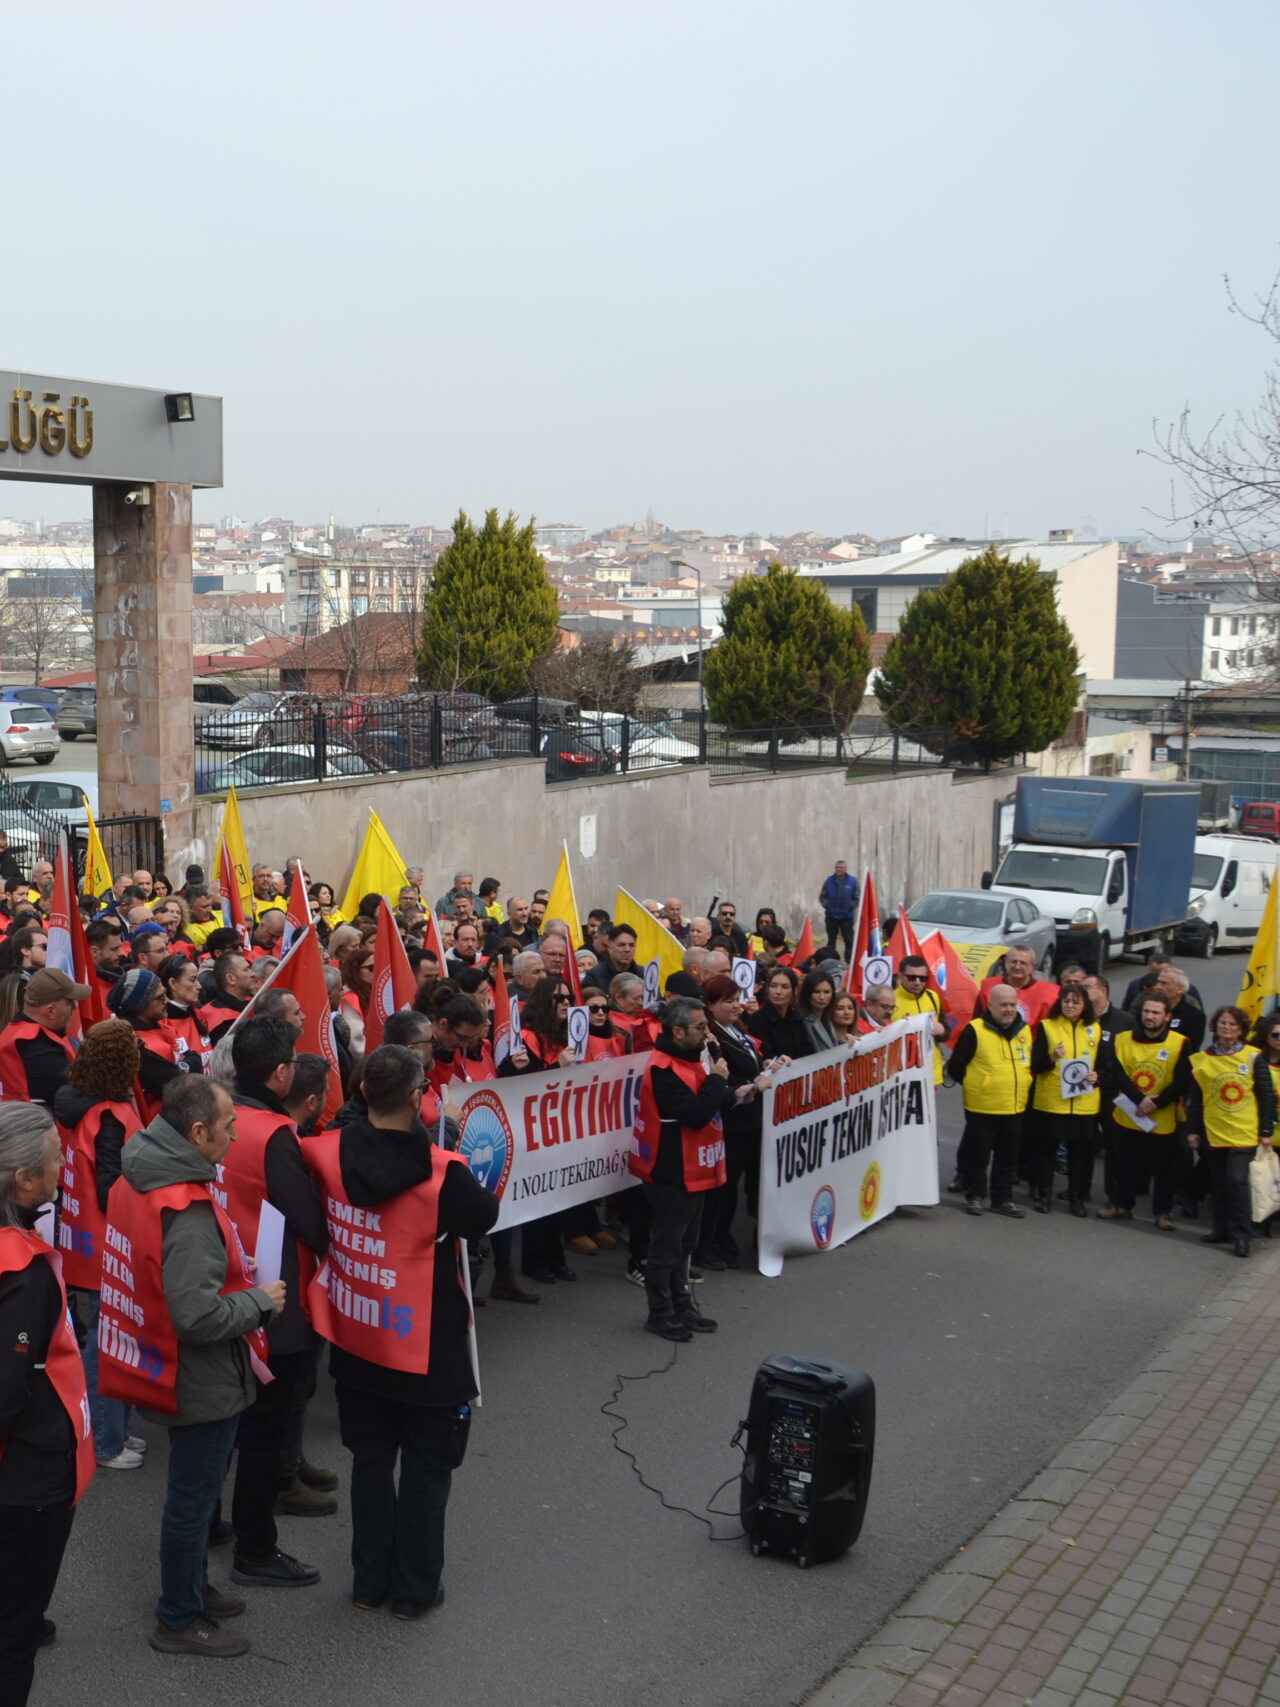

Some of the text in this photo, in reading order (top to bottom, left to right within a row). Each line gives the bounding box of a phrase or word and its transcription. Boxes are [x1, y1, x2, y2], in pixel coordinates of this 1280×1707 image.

[776, 1118, 829, 1189] YUSUF
[831, 1095, 874, 1162] TEKİN
[512, 1181, 518, 1201] 1
[520, 1169, 559, 1199] NOLU
[560, 1149, 619, 1188] TEKİRDAĞ
[326, 1219, 386, 1258] EYLEM
[327, 1196, 382, 1232] EMEK
[100, 1276, 145, 1328] İRENİŞ
[98, 1311, 165, 1383] itimiş
